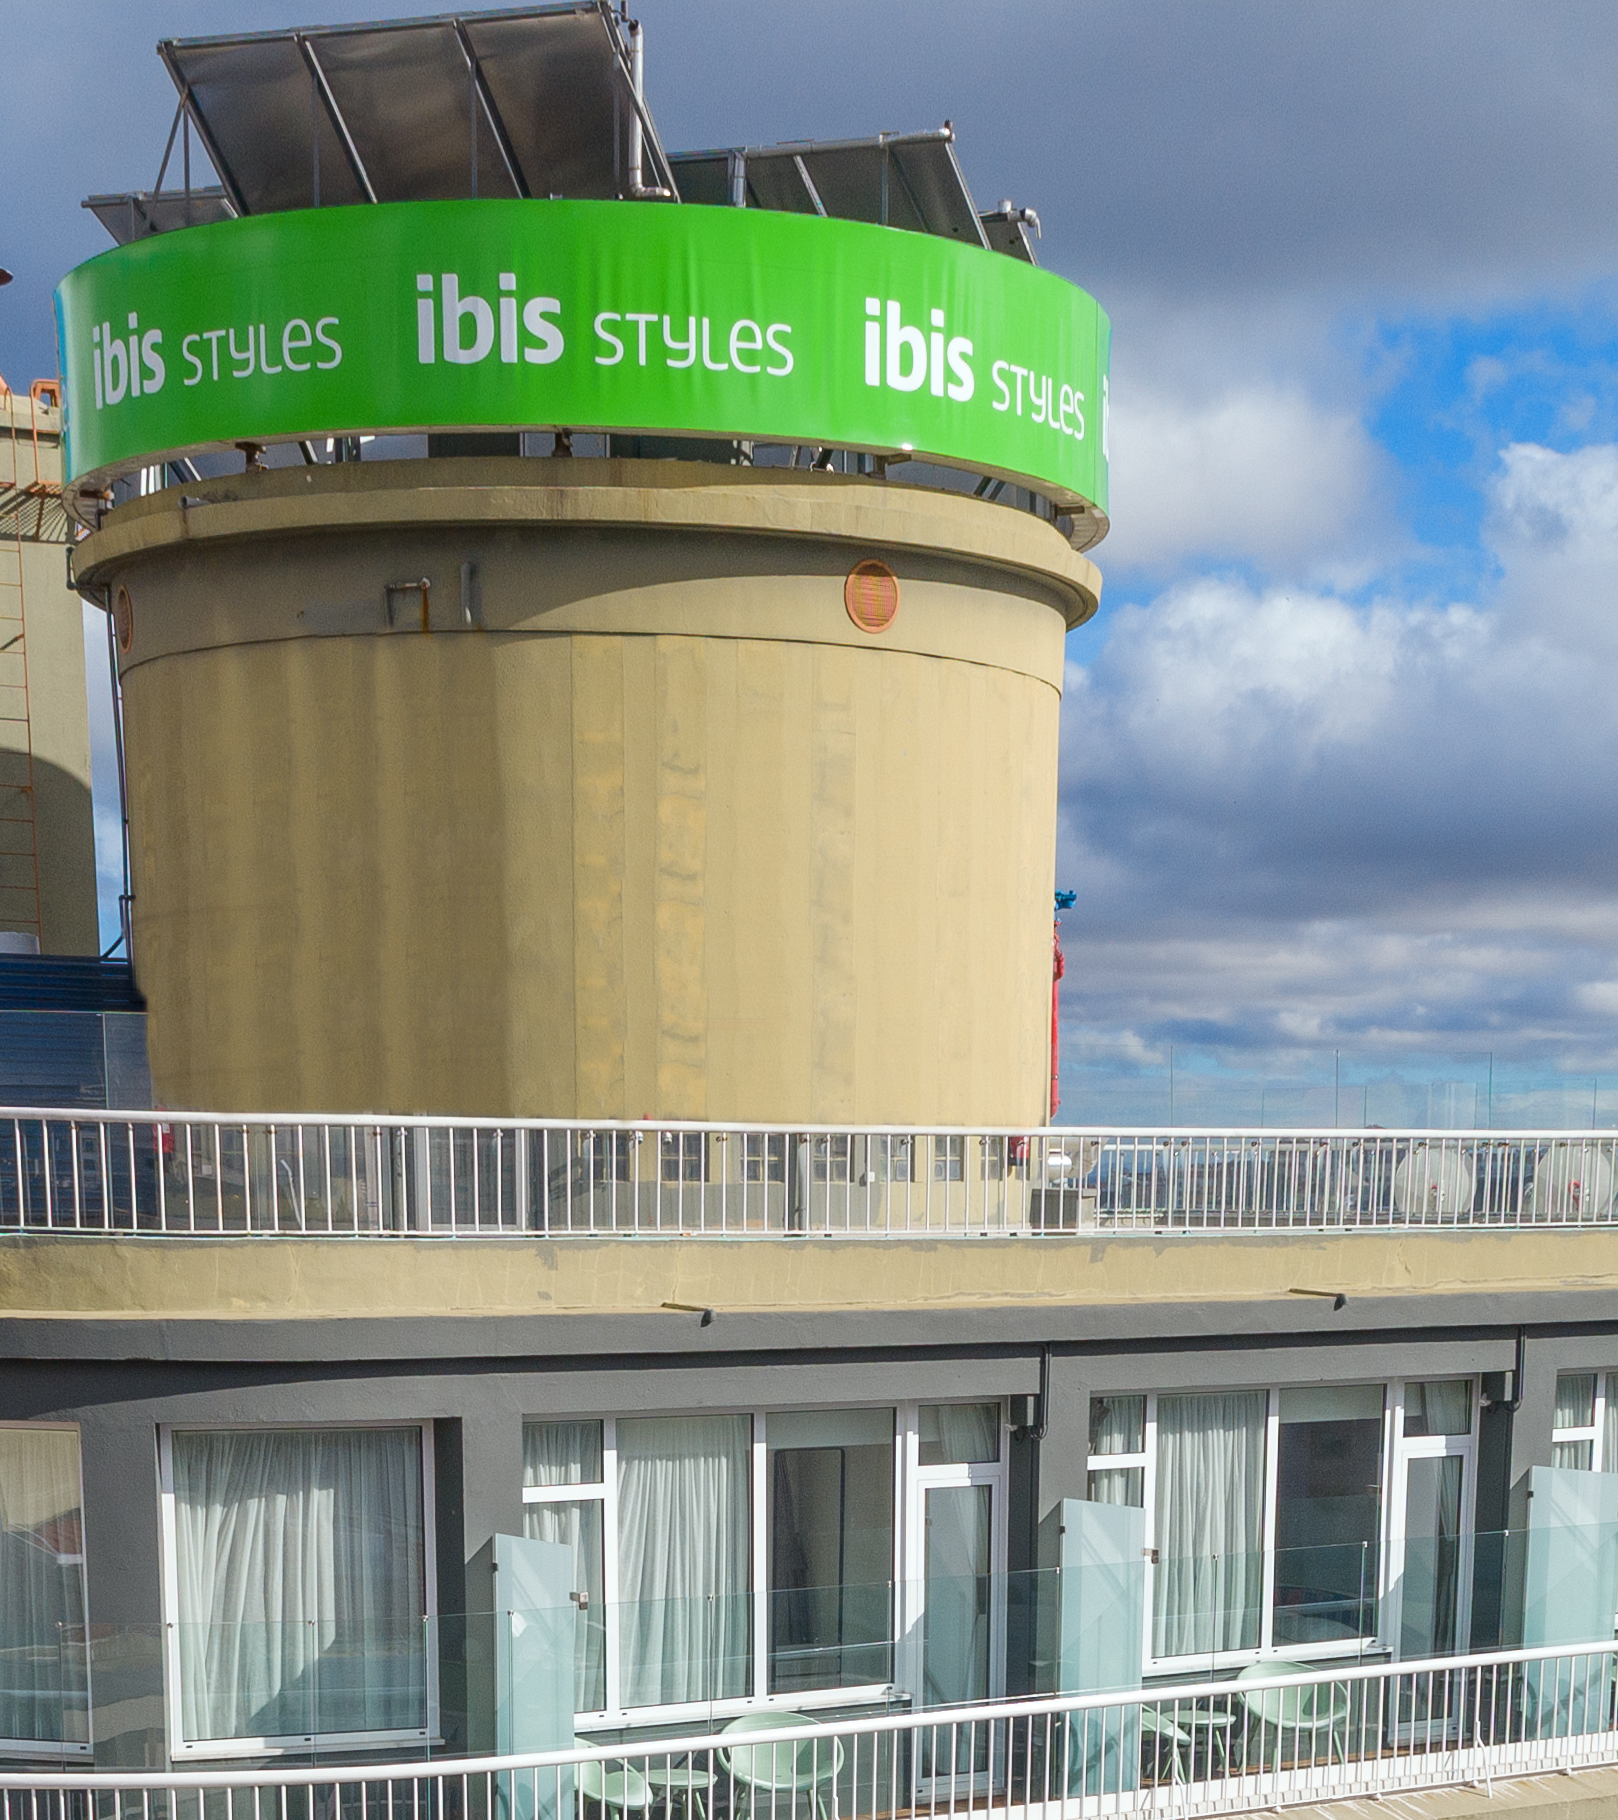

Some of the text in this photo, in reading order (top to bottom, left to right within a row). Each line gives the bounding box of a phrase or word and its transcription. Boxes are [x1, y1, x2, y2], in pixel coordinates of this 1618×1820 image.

[92, 311, 166, 410] ibis
[416, 272, 565, 365] ibis
[863, 296, 976, 404] ibis
